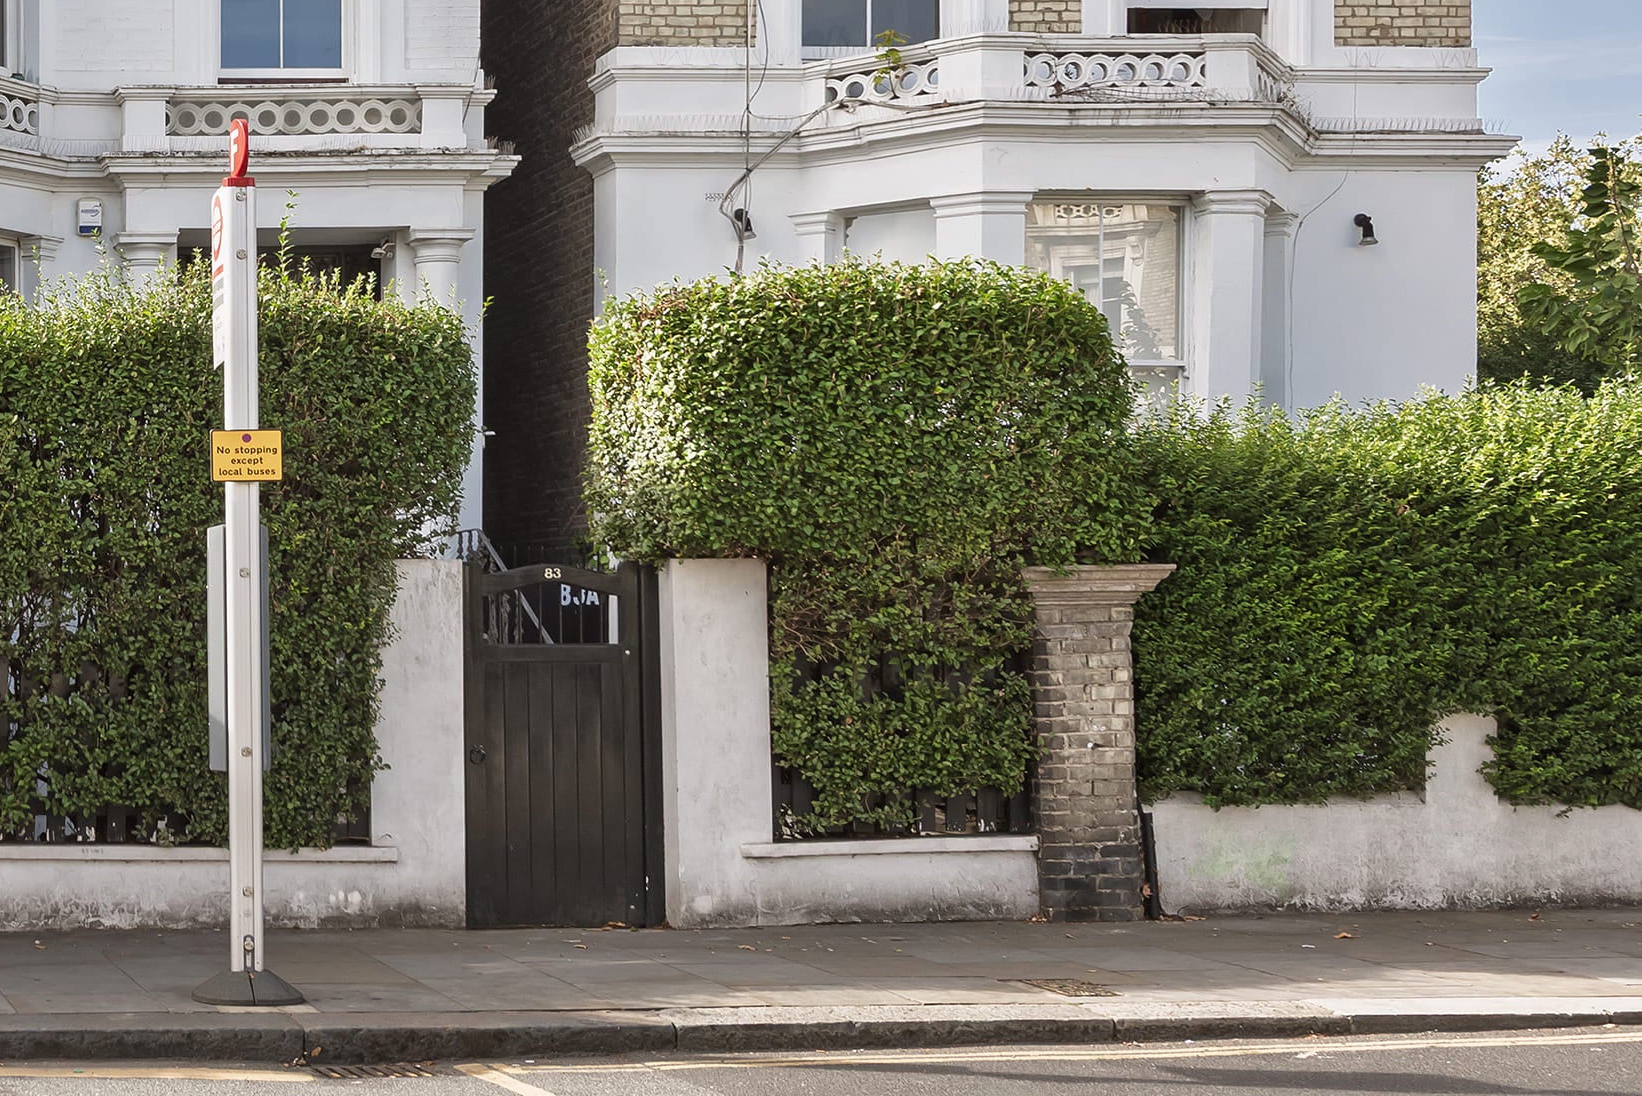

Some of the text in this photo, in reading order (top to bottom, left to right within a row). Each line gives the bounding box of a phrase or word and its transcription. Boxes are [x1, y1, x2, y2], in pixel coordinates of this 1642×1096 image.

[230, 128, 239, 172] F
[216, 445, 278, 455] No stopping
[230, 457, 264, 466] except
[218, 467, 277, 476] local buses
[544, 567, 562, 579] 83
